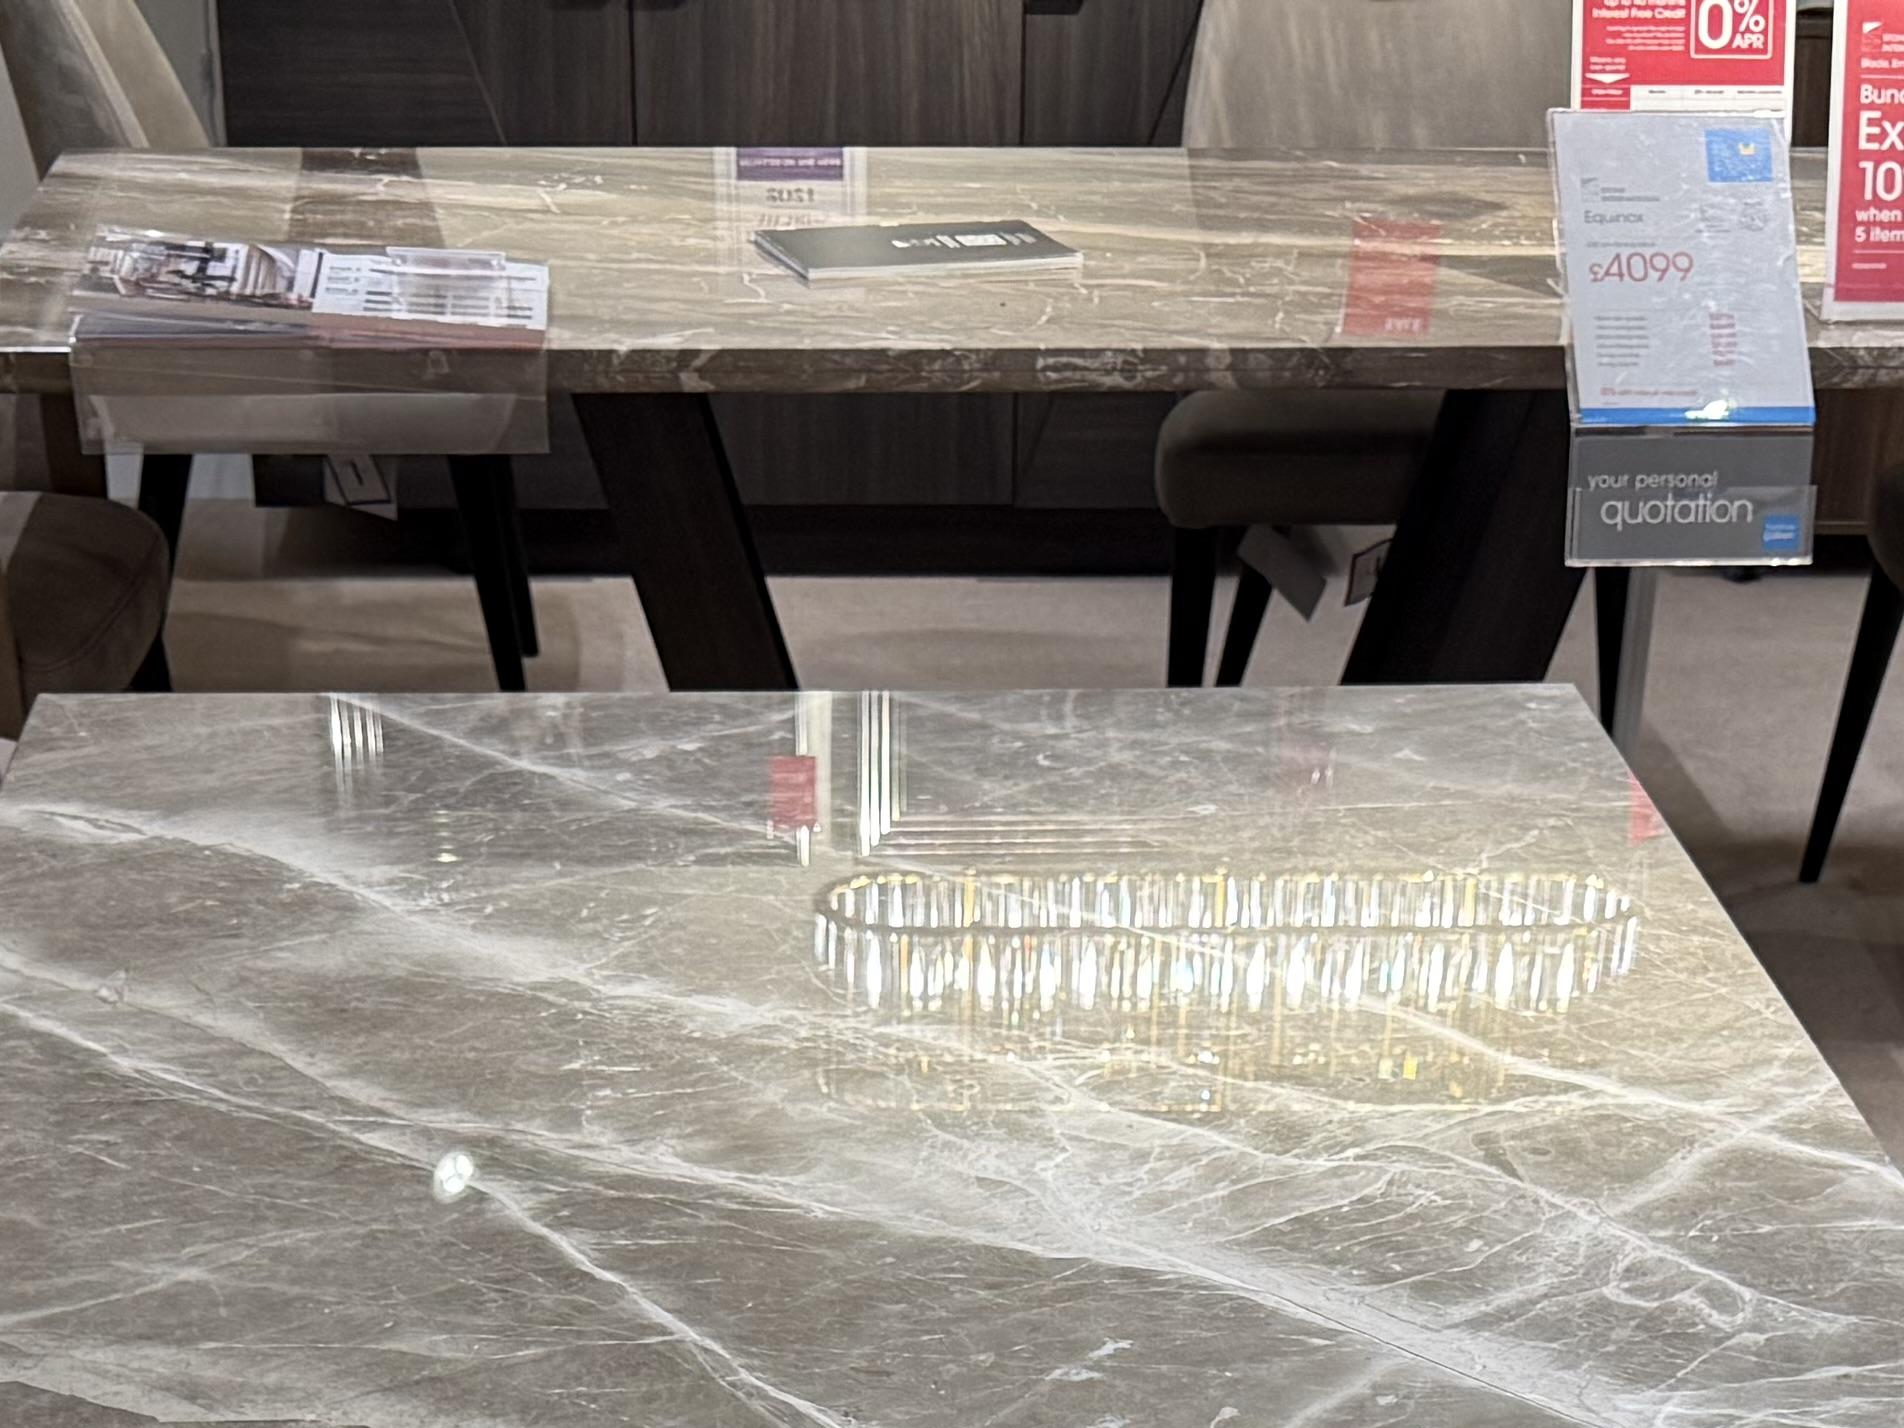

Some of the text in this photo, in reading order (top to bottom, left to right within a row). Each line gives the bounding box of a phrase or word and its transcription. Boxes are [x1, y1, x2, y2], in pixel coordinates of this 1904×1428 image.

[1592, 7, 1685, 18] Interest Free Credit
[1698, 0, 1765, 49] 0%
[1732, 32, 1764, 48] APR
[1584, 210, 1643, 226] Equinox
[1856, 207, 1901, 222] when
[1855, 227, 1866, 242] 5
[1589, 252, 1694, 283] £4099
[1588, 471, 1718, 490] your personal
[1600, 492, 1754, 531] quotation
